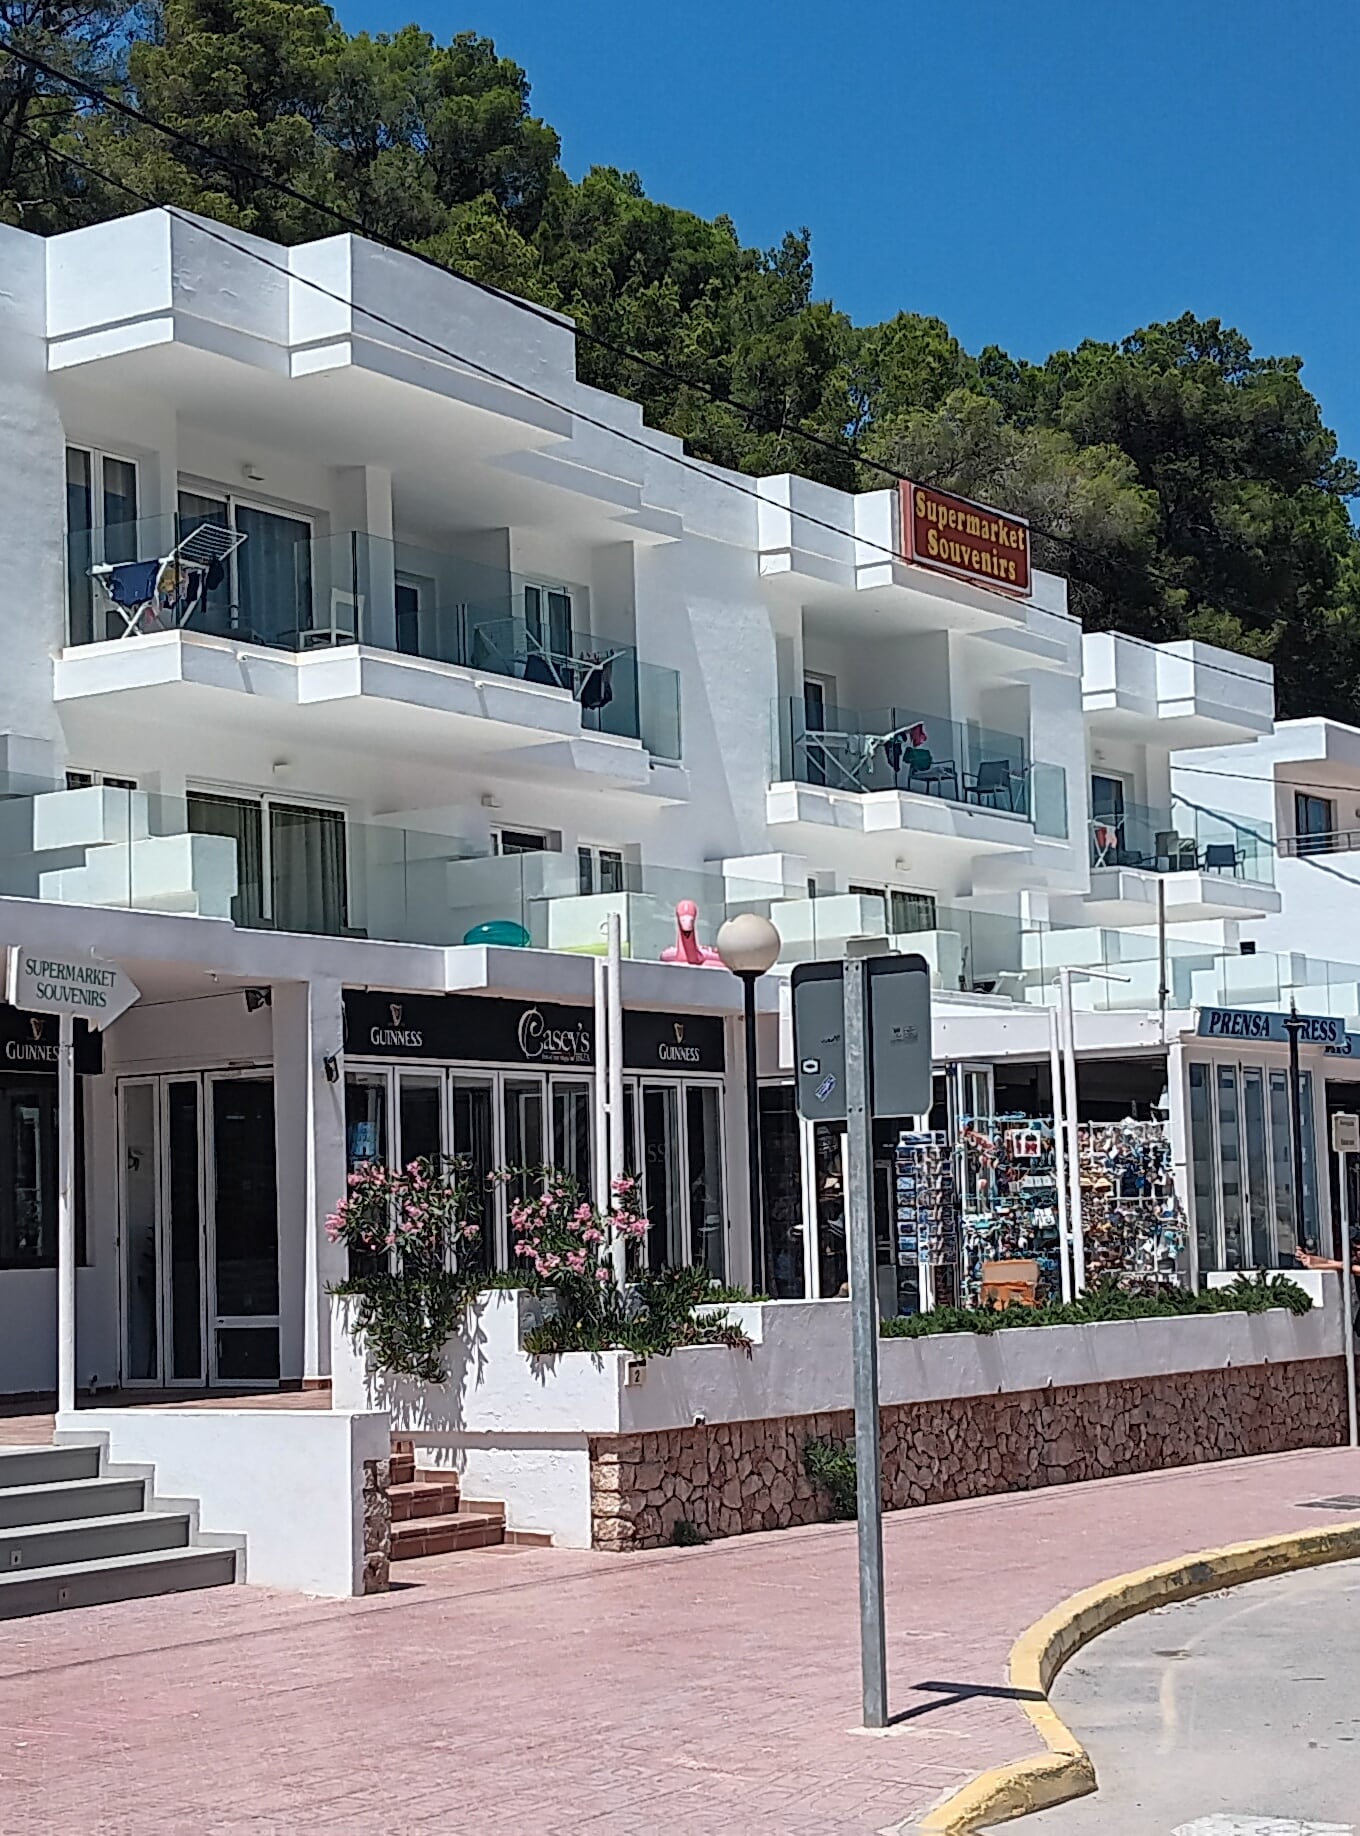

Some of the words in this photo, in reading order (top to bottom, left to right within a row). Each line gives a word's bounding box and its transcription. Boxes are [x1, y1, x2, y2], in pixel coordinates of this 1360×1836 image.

[915, 491, 1025, 551] Supermarket
[927, 528, 1017, 581] Souvenirs
[25, 958, 117, 988] SUPERMARKET
[36, 982, 107, 1008] SOUVENIRS
[370, 1026, 423, 1047] GUINNESS
[517, 1005, 590, 1060] Casey's
[1209, 1011, 1270, 1037] PRENSA
[1293, 1018, 1337, 1042] RESS
[5, 1040, 60, 1062] GUINNES
[658, 1043, 700, 1062] GUINNESS
